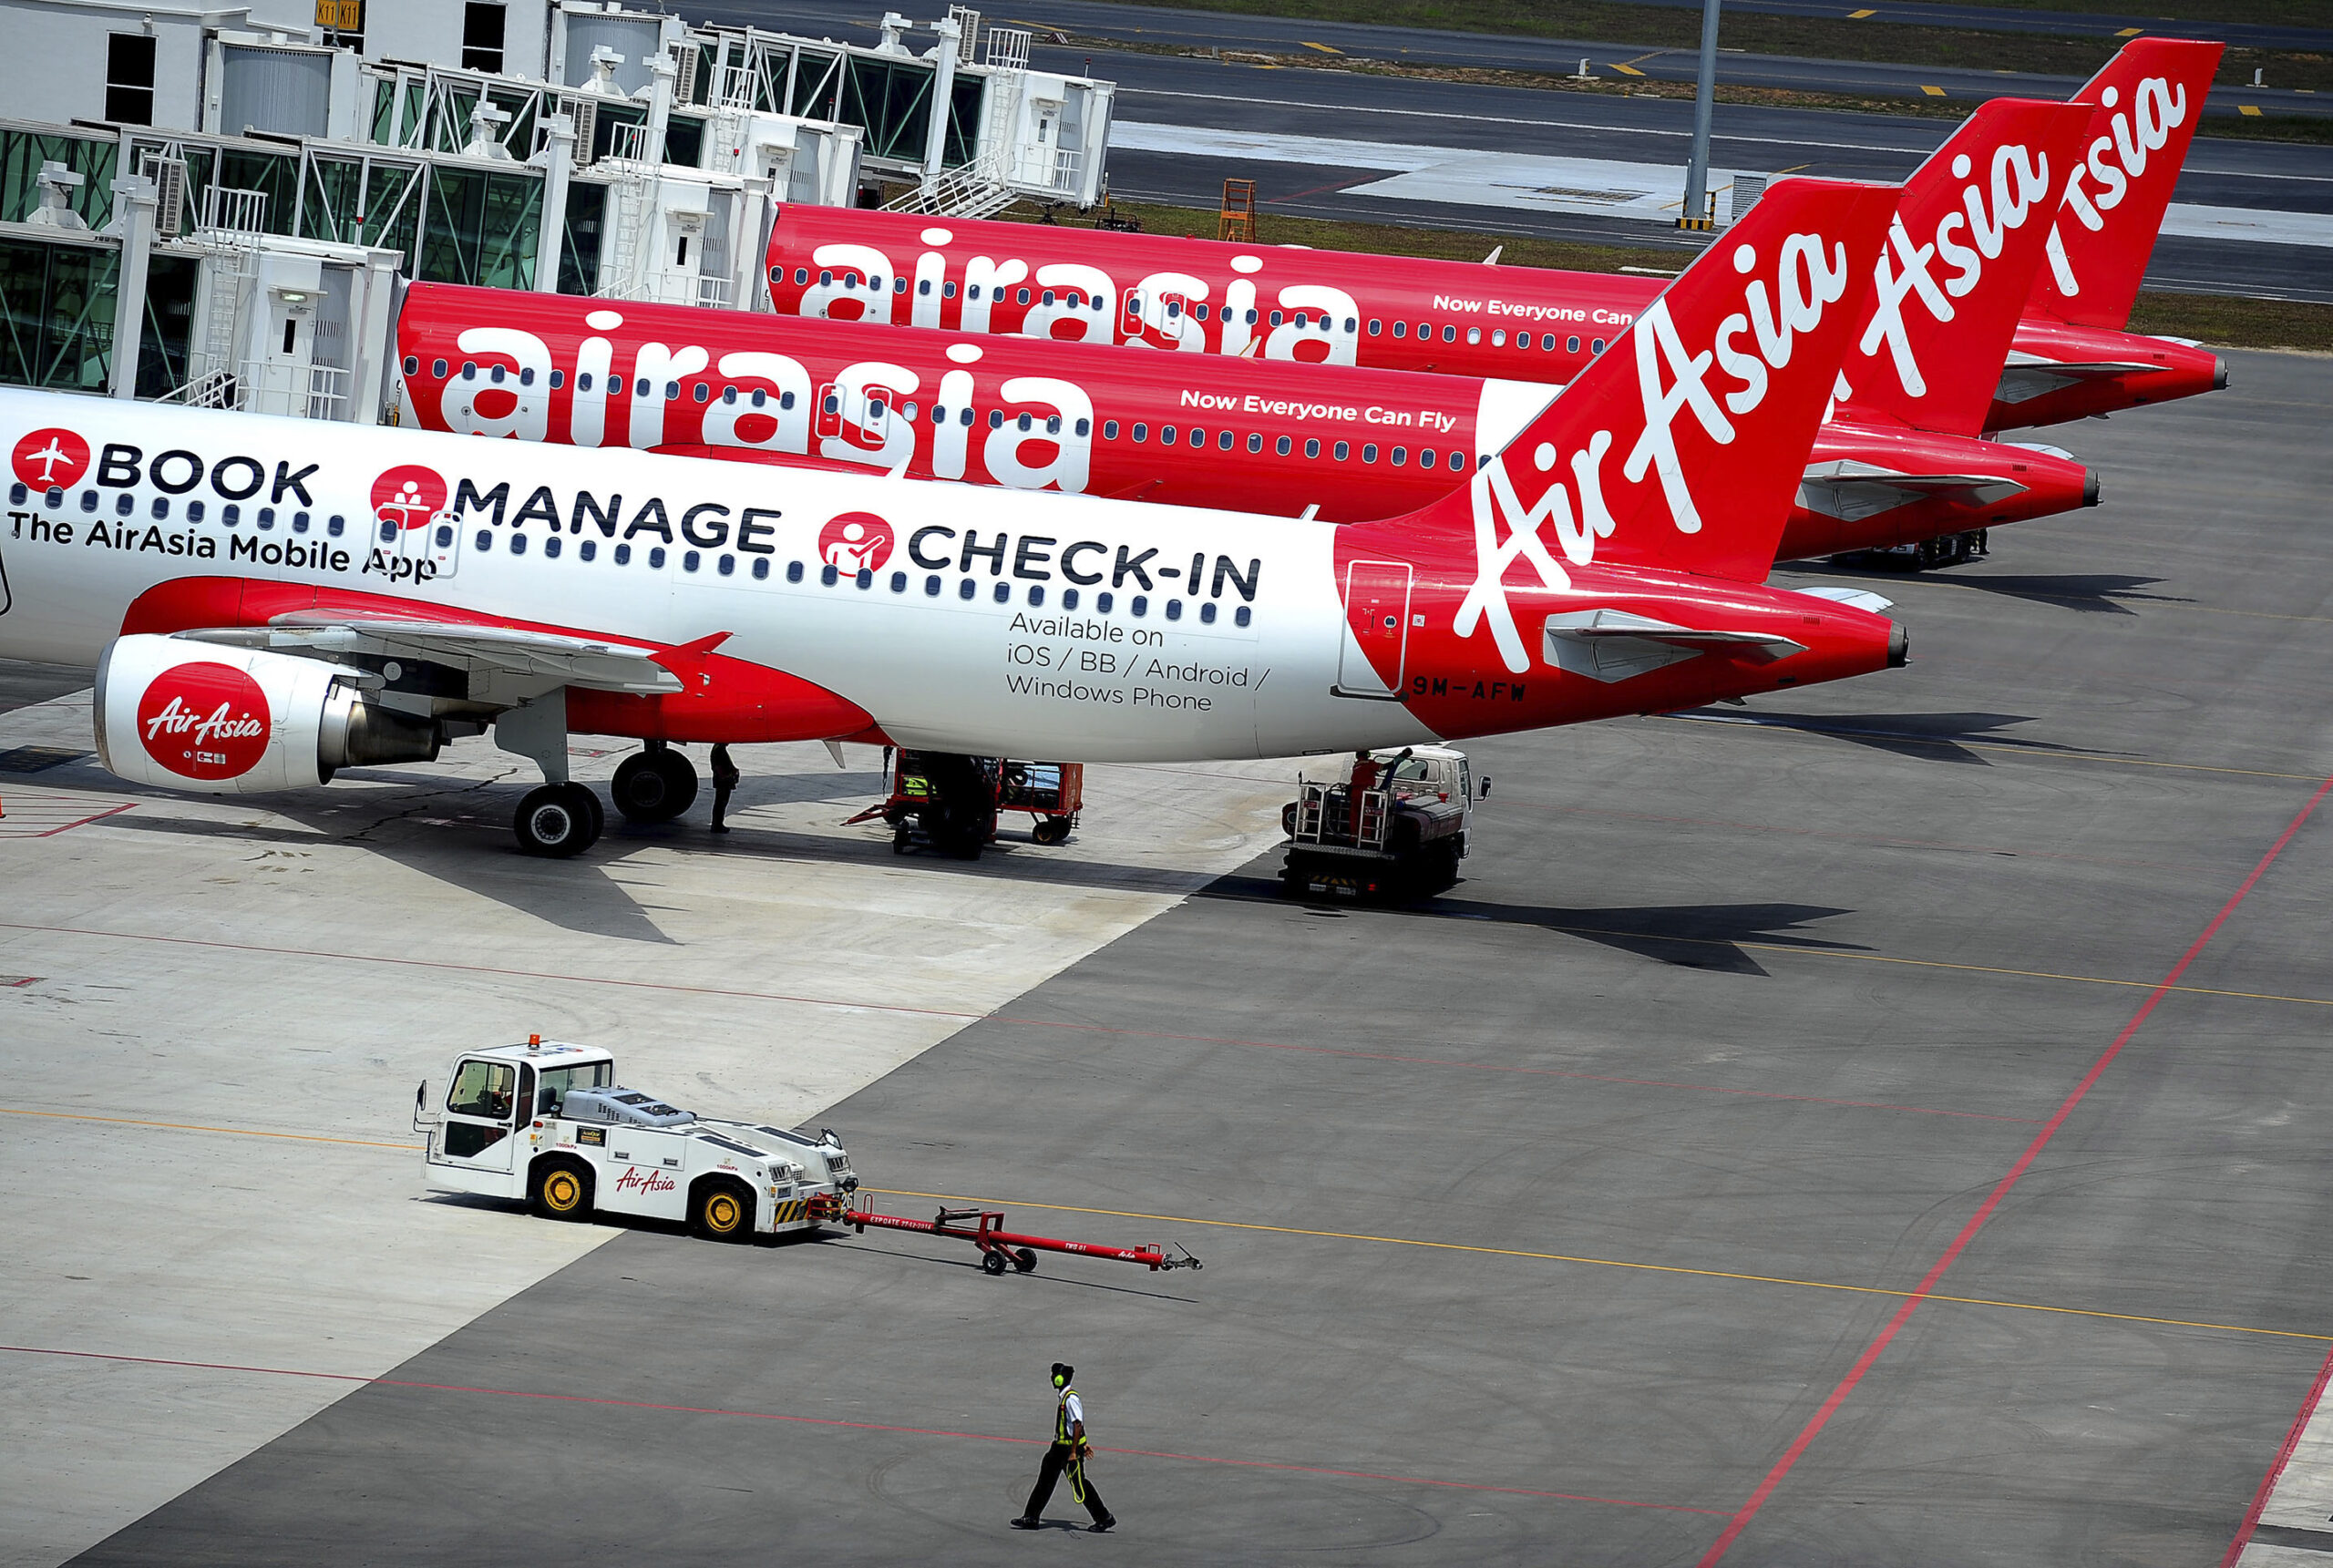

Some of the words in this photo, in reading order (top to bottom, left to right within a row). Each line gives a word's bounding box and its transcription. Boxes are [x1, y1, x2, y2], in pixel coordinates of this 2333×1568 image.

[318, 4, 334, 22] K11
[340, 5, 356, 25] K11
[799, 227, 1361, 367] airasia
[1433, 294, 1483, 313] Now
[1487, 299, 1586, 321] Everyone
[1591, 309, 1634, 326] Can
[440, 311, 1094, 493] airasia
[1180, 389, 1238, 410] Now
[1243, 395, 1357, 421] Everyone
[1365, 406, 1411, 425] Can
[1418, 410, 1456, 433] Fly
[96, 443, 320, 507] BOOK
[453, 478, 782, 554] MANAGE
[7, 511, 74, 546] The
[86, 520, 215, 559] AirAsia
[229, 534, 350, 571] Mobile
[362, 548, 437, 586] App
[909, 525, 1261, 601] CHECK-IN
[1009, 612, 1124, 643] Available
[1133, 629, 1164, 647] on
[1007, 643, 1051, 667] iOS
[1080, 651, 1116, 673] BB
[1145, 658, 1249, 688] Android
[1006, 674, 1124, 704] Windows
[1133, 688, 1213, 712] Phone
[1413, 675, 1526, 702] 9M-AFW
[840, 1192, 853, 1210] 26
